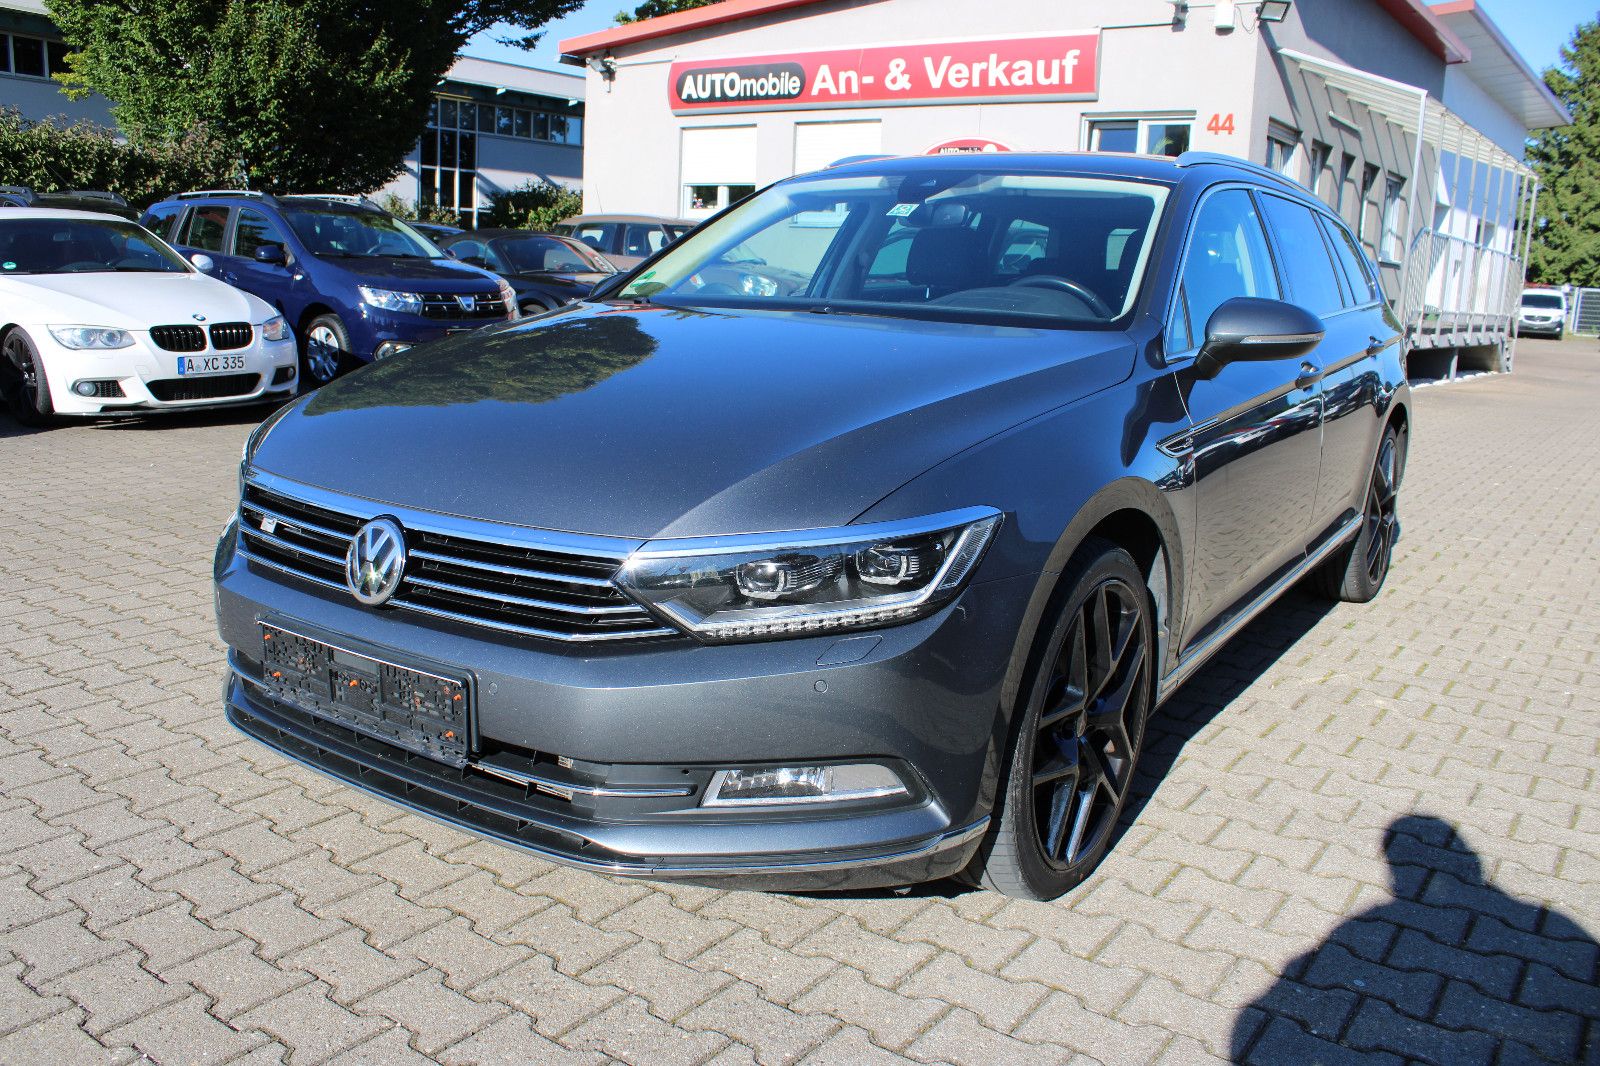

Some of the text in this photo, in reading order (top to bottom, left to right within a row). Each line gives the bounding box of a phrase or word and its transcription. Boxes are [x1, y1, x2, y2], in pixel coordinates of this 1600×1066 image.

[681, 49, 1081, 100] AUTOmobile An- & Verkauf
[1206, 113, 1235, 135] 44
[187, 356, 244, 372] A XC 335
